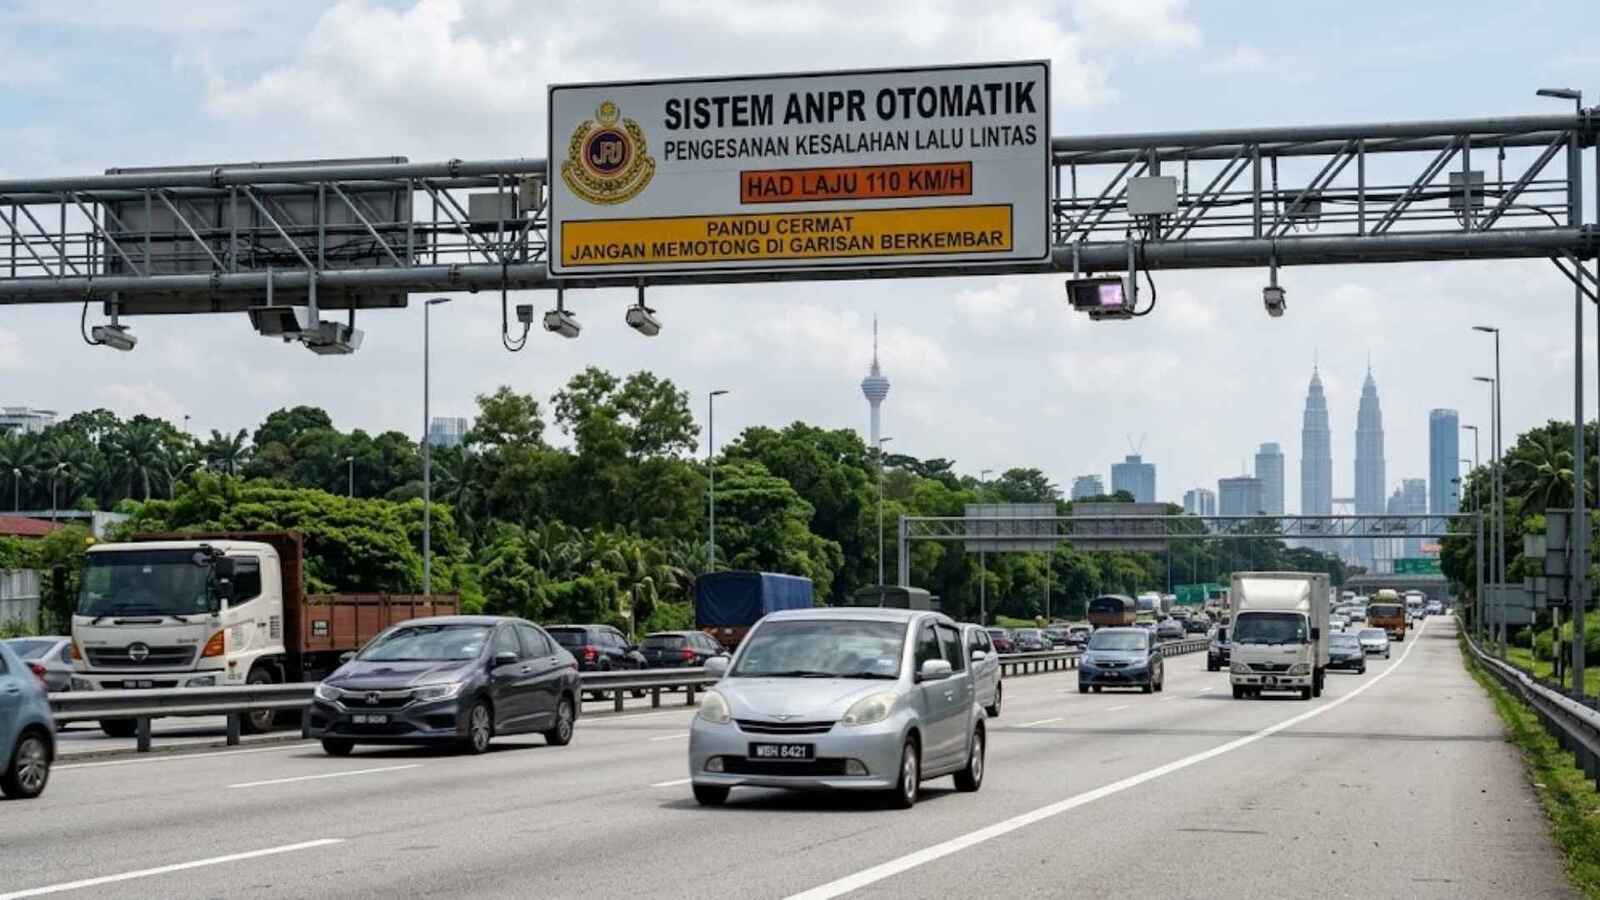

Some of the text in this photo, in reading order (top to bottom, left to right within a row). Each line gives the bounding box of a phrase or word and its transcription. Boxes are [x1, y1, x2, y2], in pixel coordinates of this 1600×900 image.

[665, 81, 1037, 130] SISTEM ANPR OTOMATIK
[664, 124, 1037, 161] PENGESANAN KESALAHAN LALU LINTAS
[748, 169, 965, 197] HAD LAJU 110 KM/H
[706, 216, 854, 237] PANDU CERMAT
[570, 231, 1004, 261] JANGAN MEMOTONG DI GARISAN BERKEMBAR
